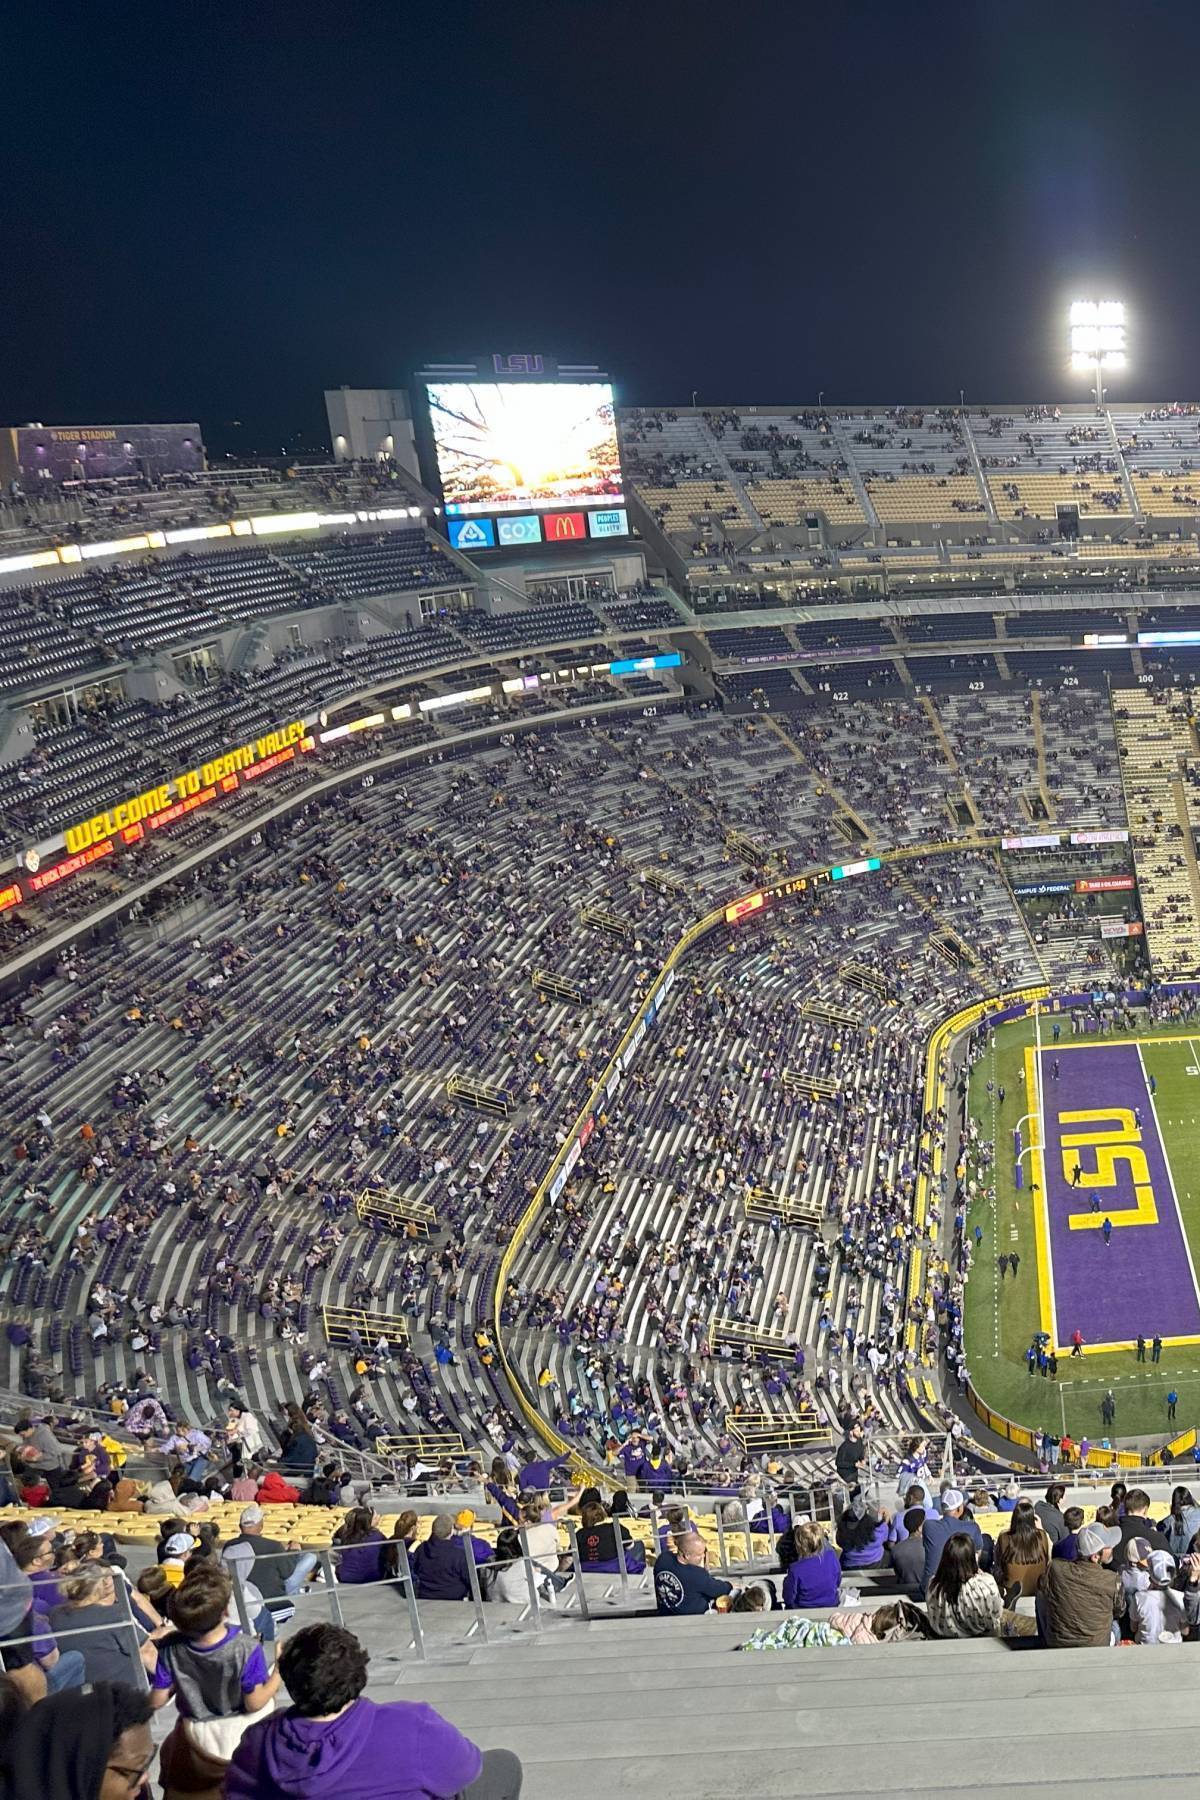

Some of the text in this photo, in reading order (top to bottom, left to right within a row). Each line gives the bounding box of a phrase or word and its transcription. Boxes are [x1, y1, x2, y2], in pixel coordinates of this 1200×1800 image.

[493, 354, 544, 374] LSU
[57, 430, 117, 441] TIGER STADIUM
[500, 523, 539, 538] COX
[1063, 677, 1079, 686] 424
[1138, 674, 1154, 683] 100
[968, 680, 984, 691] 423
[833, 692, 849, 701] 422
[643, 706, 657, 717] 421
[361, 774, 374, 787] 419
[65, 784, 173, 854] WELCOME
[173, 770, 200, 798] TO
[202, 745, 254, 786] DEATH
[256, 720, 306, 759] VALLEY
[1014, 884, 1070, 895] CAMPUS FEDERAL
[1058, 1108, 1159, 1230] LSU
